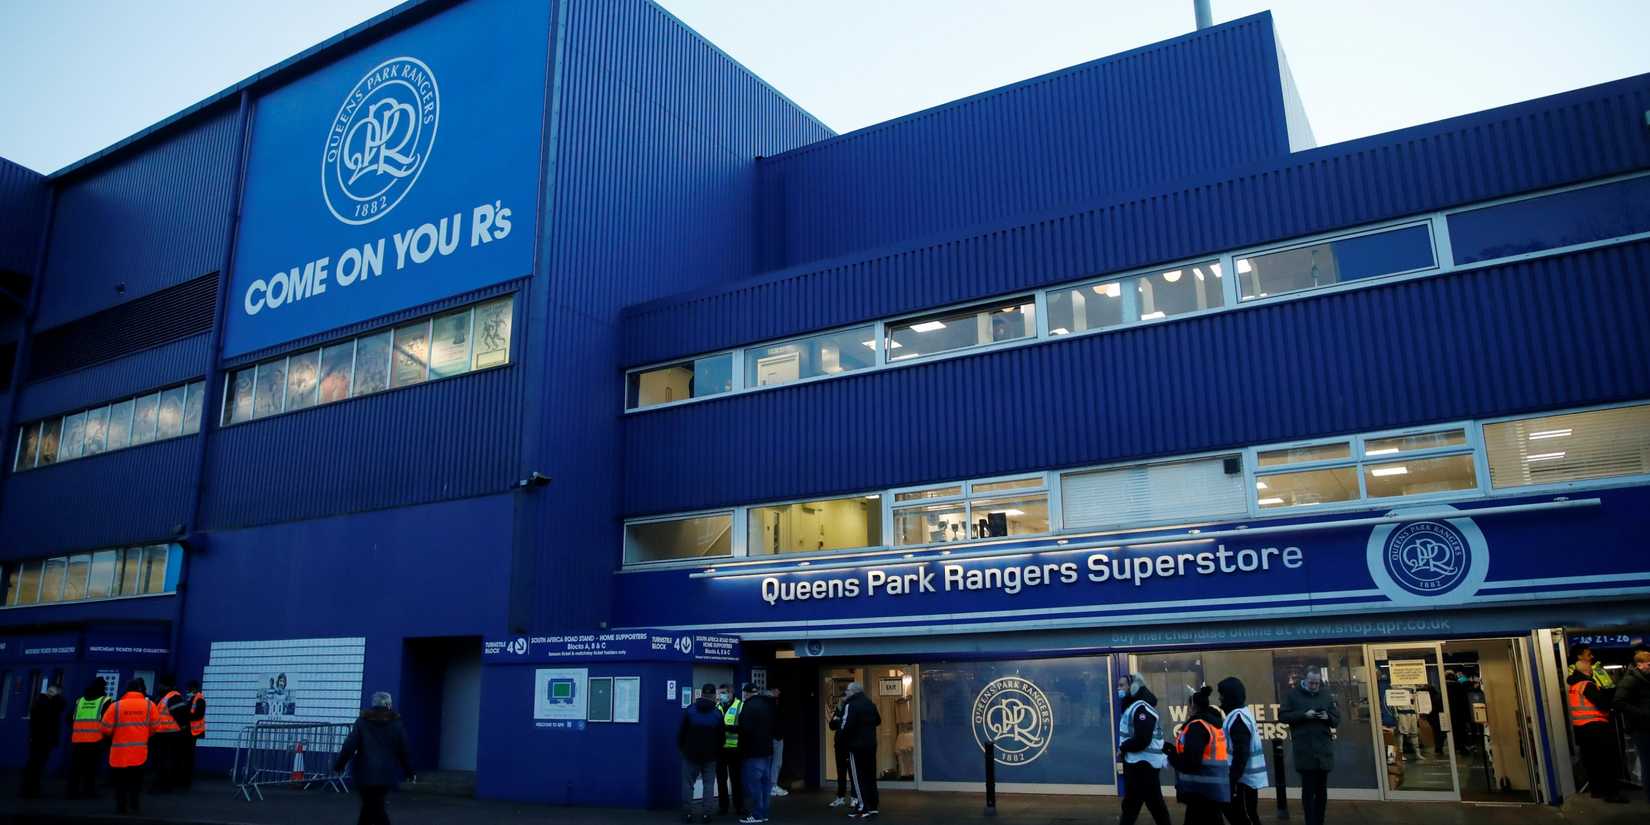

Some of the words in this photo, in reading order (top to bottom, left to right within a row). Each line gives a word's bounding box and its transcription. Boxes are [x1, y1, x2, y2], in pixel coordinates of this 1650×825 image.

[327, 89, 364, 163] QUEENS
[367, 64, 400, 90] PARK
[401, 64, 434, 125] RANGERS
[354, 196, 388, 217] 1882
[244, 256, 330, 316] COME
[336, 237, 386, 287] ON
[392, 212, 462, 270] YOU
[1391, 530, 1410, 561] QUEENS
[1410, 524, 1432, 533] PARK
[1433, 525, 1462, 556] RANGERS
[761, 576, 860, 606] Queens
[867, 565, 936, 597] Park
[944, 561, 1078, 595] Rangers
[1087, 544, 1304, 586] Superstore
[506, 640, 514, 654] 4
[579, 634, 595, 642] STAND
[599, 633, 615, 641] HOME
[615, 632, 648, 641] SUPPORTERS
[673, 637, 680, 651] 4
[975, 684, 996, 724] QUEENS
[996, 680, 1020, 691] PARK
[1022, 683, 1050, 723] RANGERS
[1001, 753, 1025, 762] 1882
